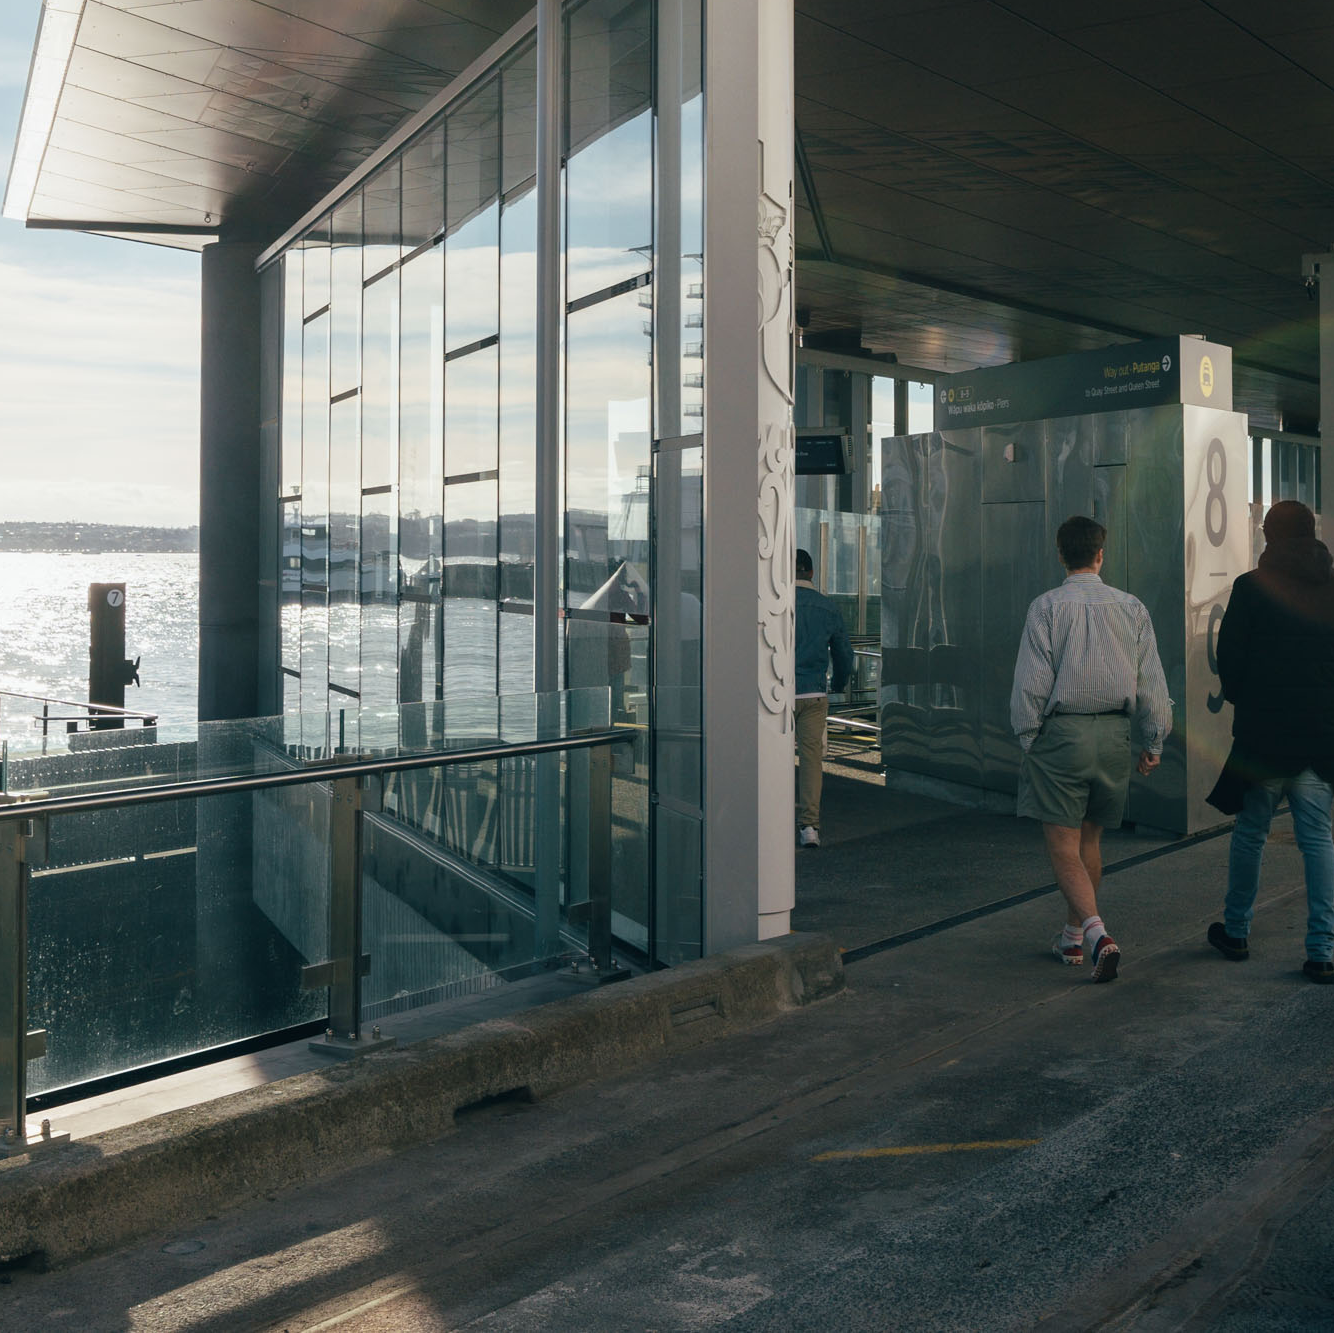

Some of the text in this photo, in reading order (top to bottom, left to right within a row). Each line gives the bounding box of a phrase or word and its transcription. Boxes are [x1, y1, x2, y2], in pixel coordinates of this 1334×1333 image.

[1103, 361, 1161, 378] Way out Putanga
[1205, 438, 1227, 547] 8
[111, 591, 119, 604] 7
